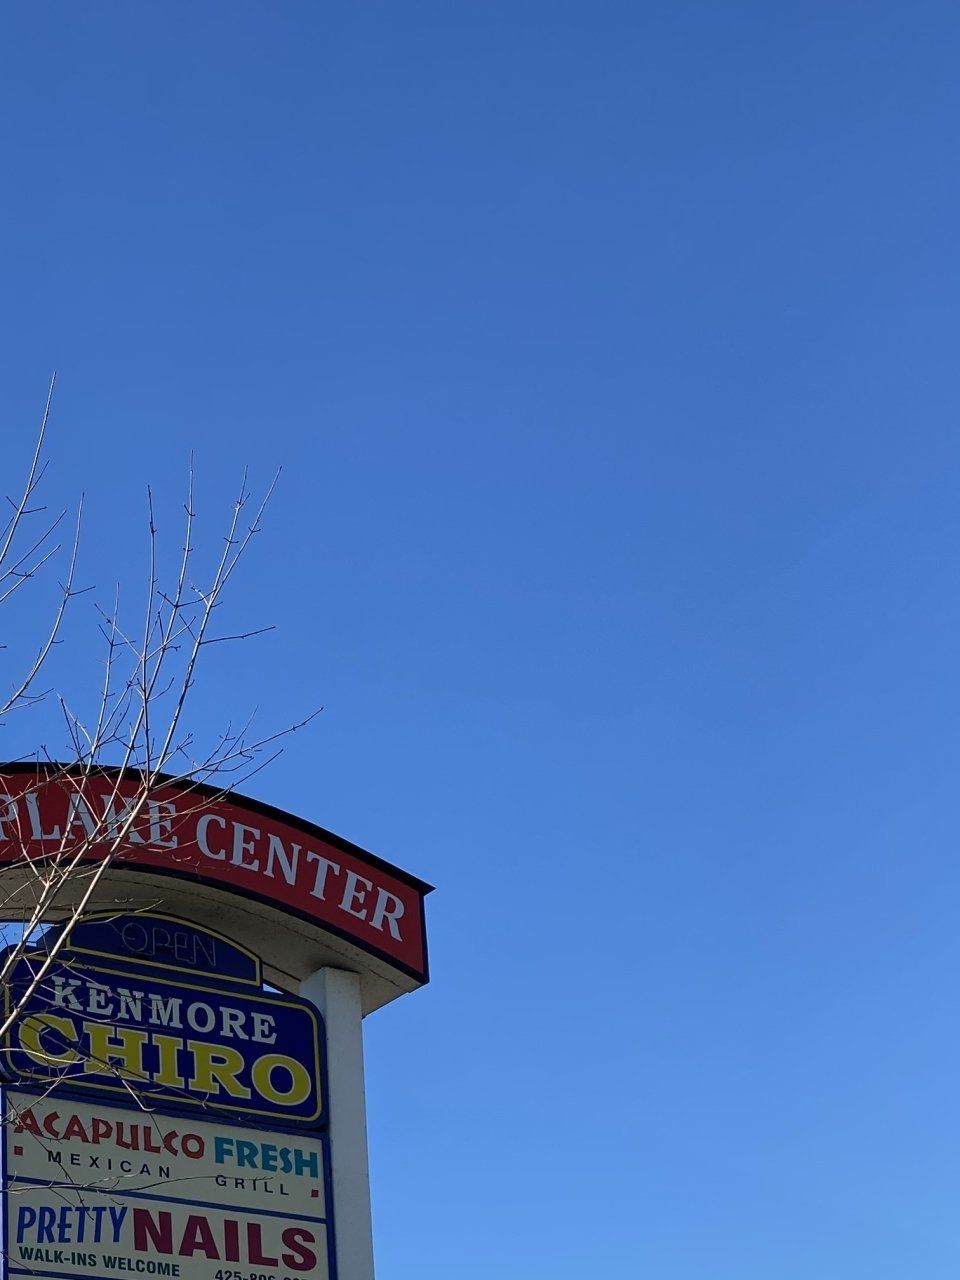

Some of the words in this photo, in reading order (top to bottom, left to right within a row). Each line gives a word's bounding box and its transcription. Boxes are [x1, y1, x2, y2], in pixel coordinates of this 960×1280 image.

[195, 813, 407, 943] CENTER
[121, 922, 216, 967] OPEN
[50, 976, 278, 1045] KENMORE
[18, 1014, 312, 1106] CHIRO
[14, 1108, 205, 1160] ACAPULCO
[213, 1136, 319, 1179] FRESH
[47, 1150, 171, 1179] MEXICAN
[215, 1174, 290, 1196] GRILL
[15, 1206, 128, 1244] PRETTY
[132, 1207, 318, 1271] NAILS
[18, 1246, 97, 1268] WALK-INS
[102, 1254, 180, 1278] WELCOME
